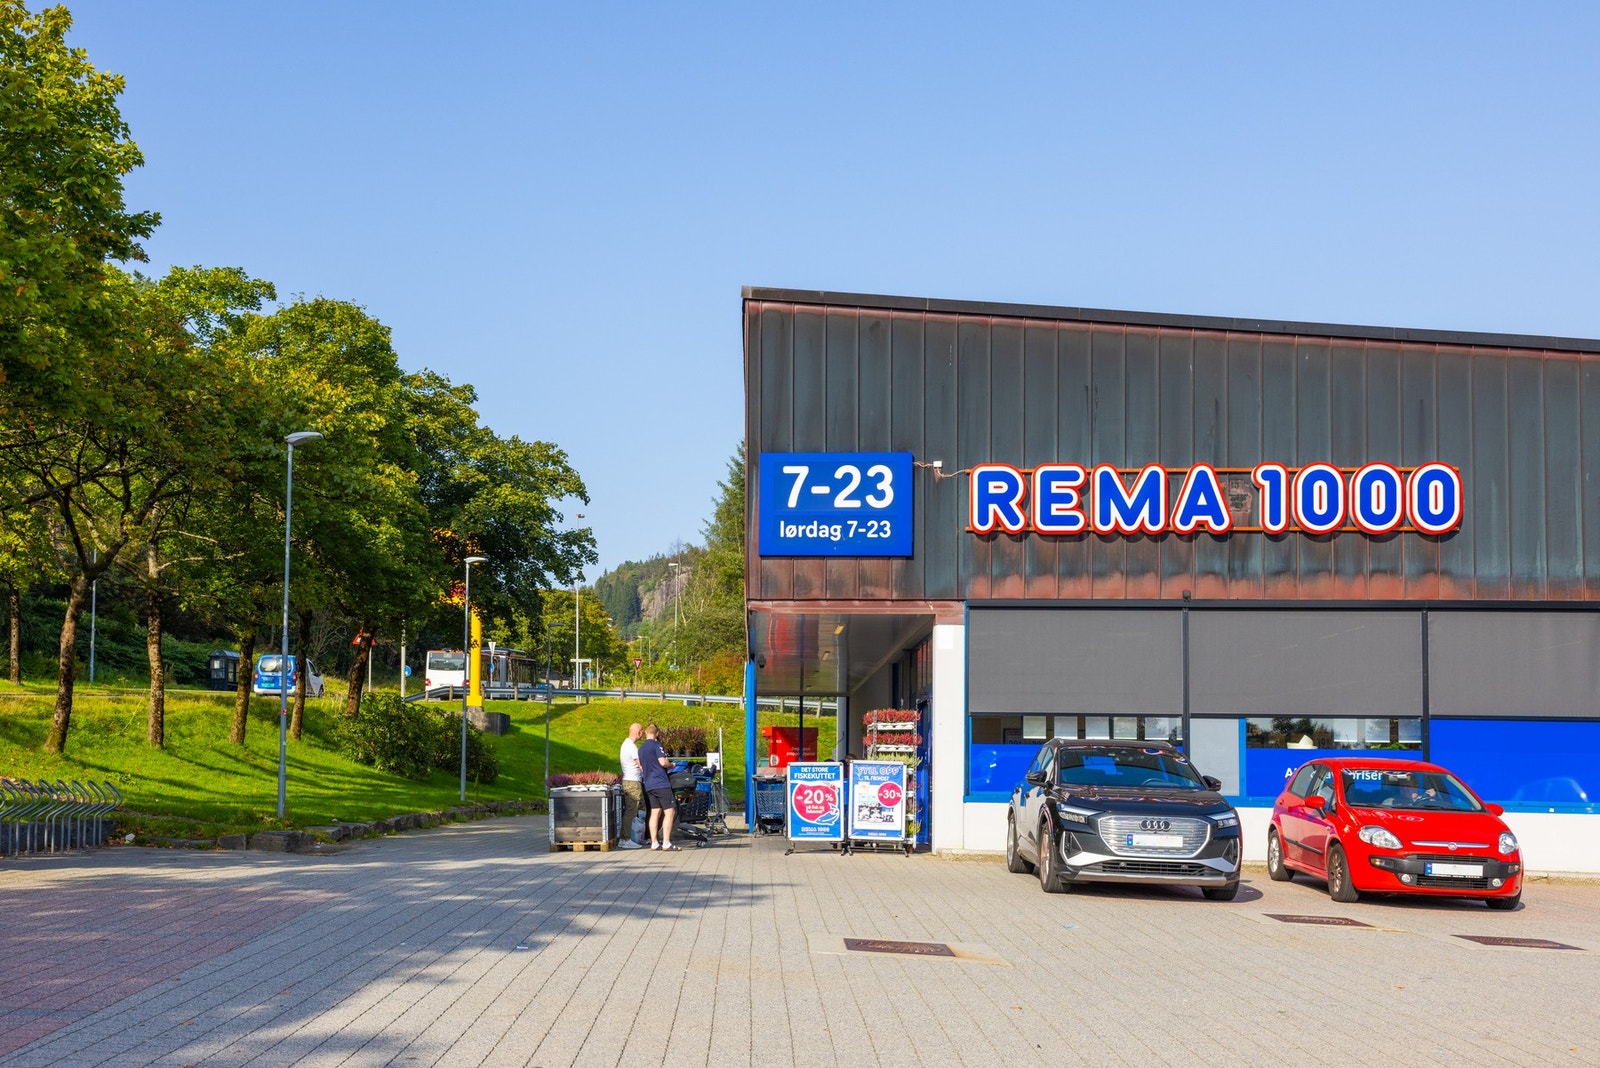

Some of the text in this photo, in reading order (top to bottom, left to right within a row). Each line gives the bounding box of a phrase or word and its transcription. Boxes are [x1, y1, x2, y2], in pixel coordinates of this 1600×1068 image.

[782, 464, 895, 509] 7-23
[970, 462, 1464, 536] REMA 1000
[780, 520, 891, 542] lørdag 7-23
[879, 766, 899, 776] OPP
